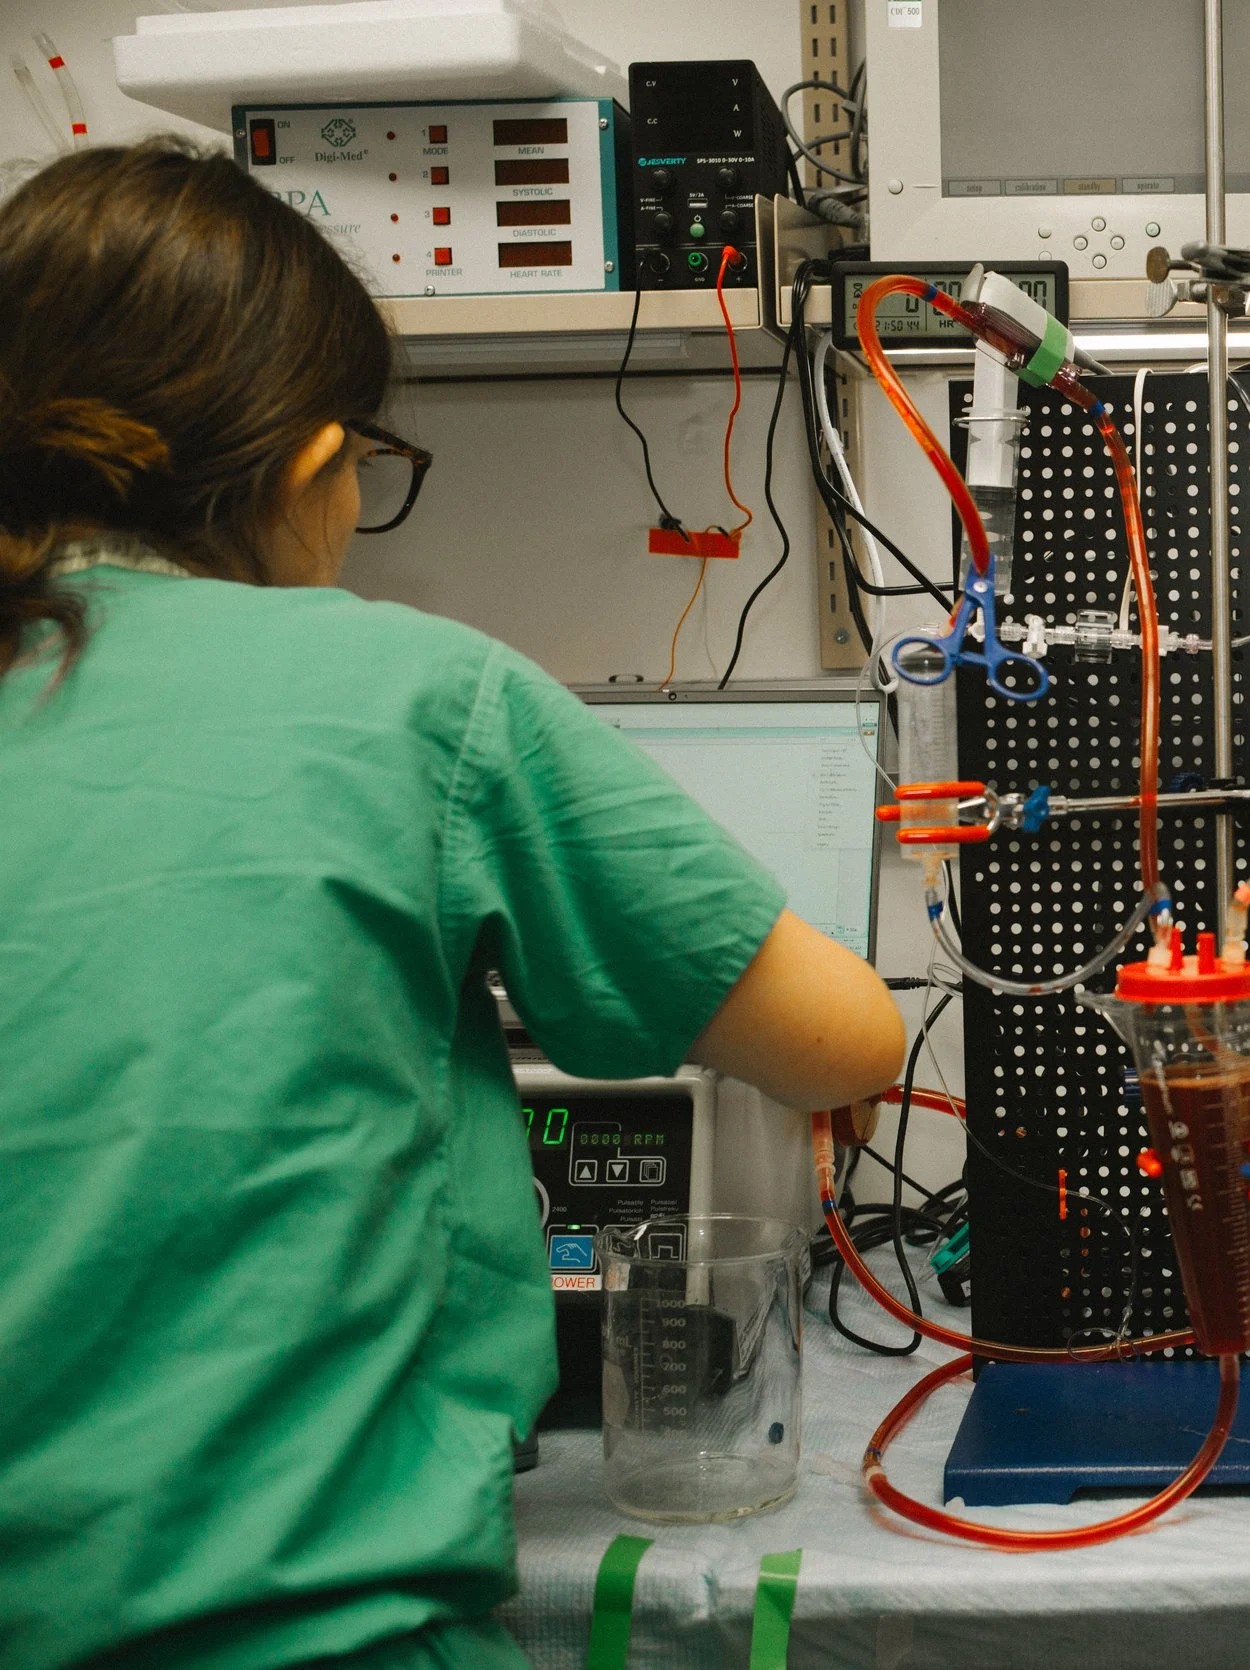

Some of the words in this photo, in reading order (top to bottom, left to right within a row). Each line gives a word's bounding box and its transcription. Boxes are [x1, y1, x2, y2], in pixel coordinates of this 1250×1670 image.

[907, 7, 920, 16] 500
[732, 78, 739, 86] V
[733, 103, 740, 112] A
[277, 121, 291, 129] ON
[421, 129, 427, 138] 1
[732, 129, 742, 138] W
[422, 147, 449, 156] MODE
[518, 146, 545, 155] MEAN
[279, 156, 296, 165] OFF
[422, 170, 430, 179] 2
[1014, 182, 1047, 192] calibration
[1077, 182, 1101, 192] standby
[512, 187, 554, 197] SYSTOLIC
[424, 210, 430, 219] 3
[512, 228, 557, 238] DIASTOLIC
[426, 250, 432, 258] 4
[425, 268, 463, 277] PRINTER
[510, 269, 538, 279] HEART
[540, 268, 563, 278] RATE
[938, 320, 955, 329] HR
[579, 1133, 621, 1146] 0000
[633, 1133, 665, 1146] RPM
[551, 1205, 568, 1213] 2400
[551, 1276, 596, 1289] OWER
[661, 1317, 687, 1327] 900
[661, 1340, 687, 1350] 800
[663, 1362, 687, 1372] 700
[663, 1384, 688, 1394] 600
[662, 1407, 688, 1416] 500
